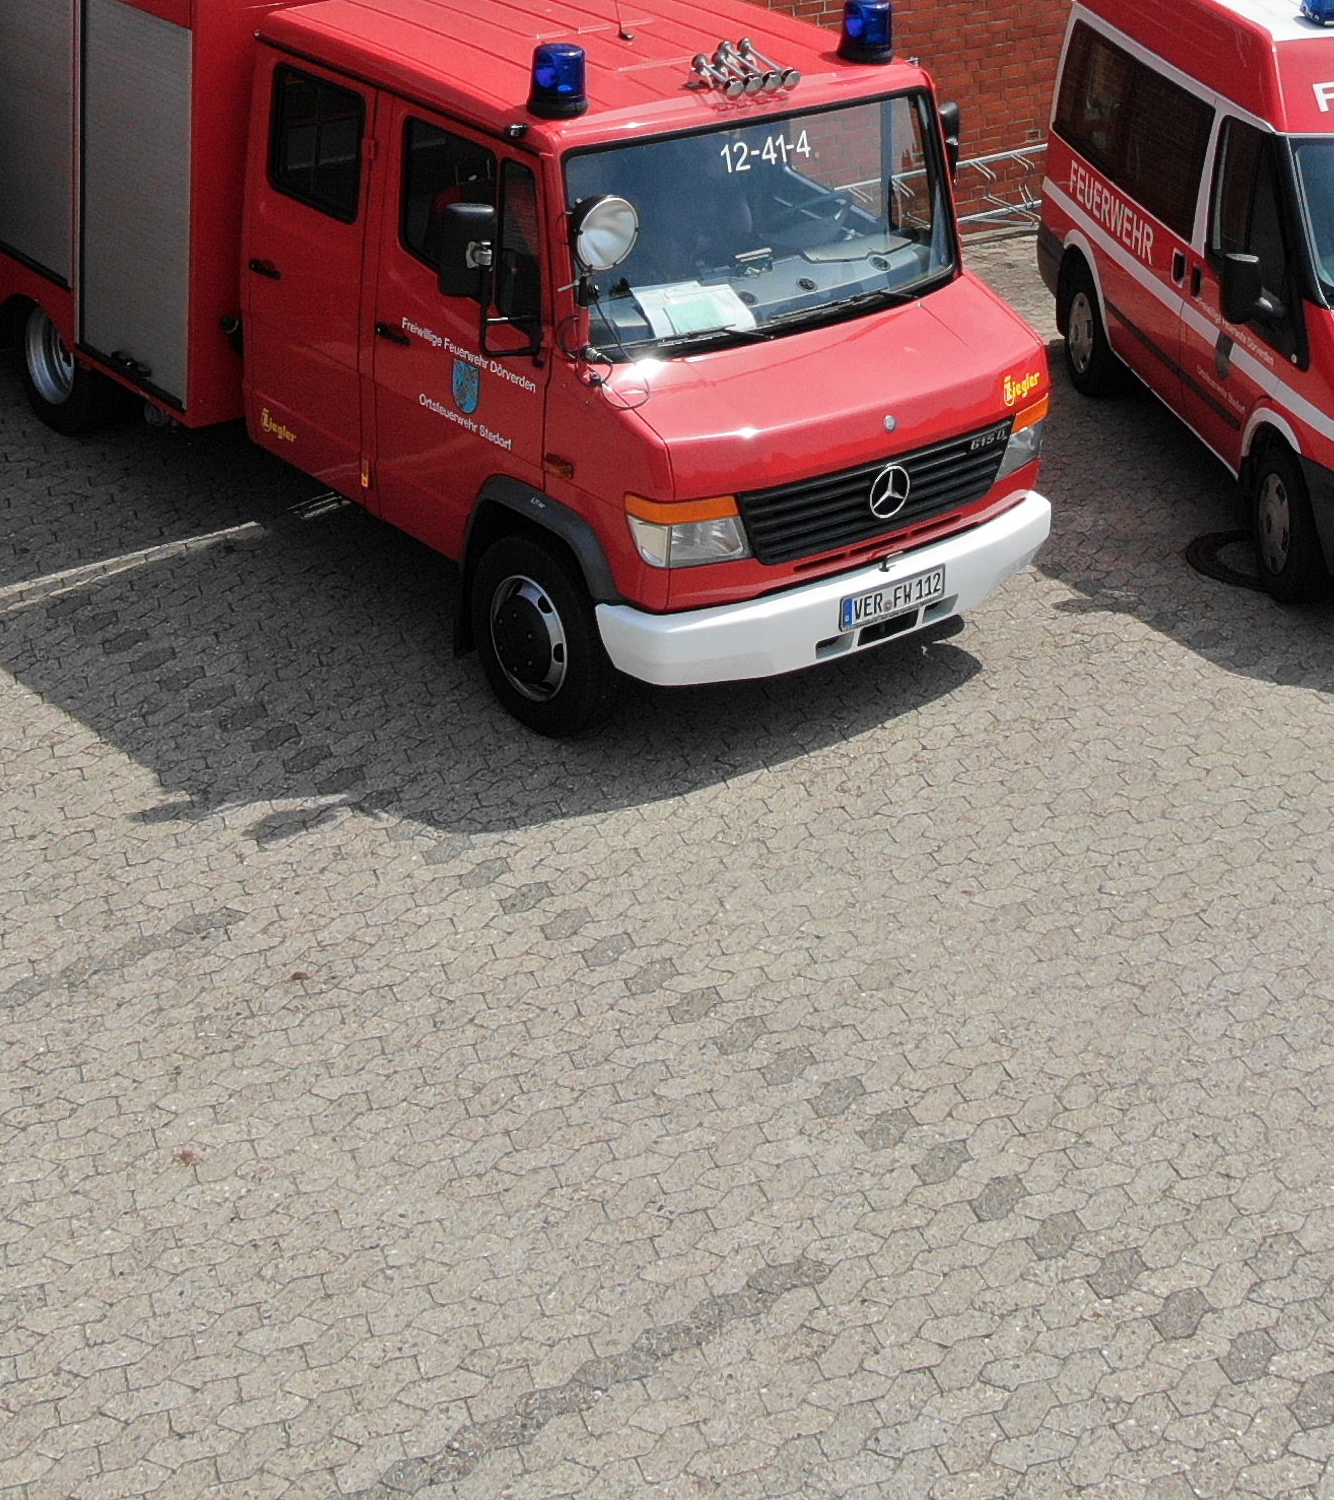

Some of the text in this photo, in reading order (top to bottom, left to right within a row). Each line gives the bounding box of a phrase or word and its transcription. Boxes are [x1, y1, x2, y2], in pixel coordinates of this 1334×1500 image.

[720, 129, 812, 173] 12-41-4
[1069, 159, 1154, 266] FEUERWEHR
[444, 338, 488, 369] Feuerwehr
[479, 424, 512, 450] Stedorf
[854, 592, 883, 620] VER
[893, 583, 913, 608] FW
[915, 572, 941, 600] 112
